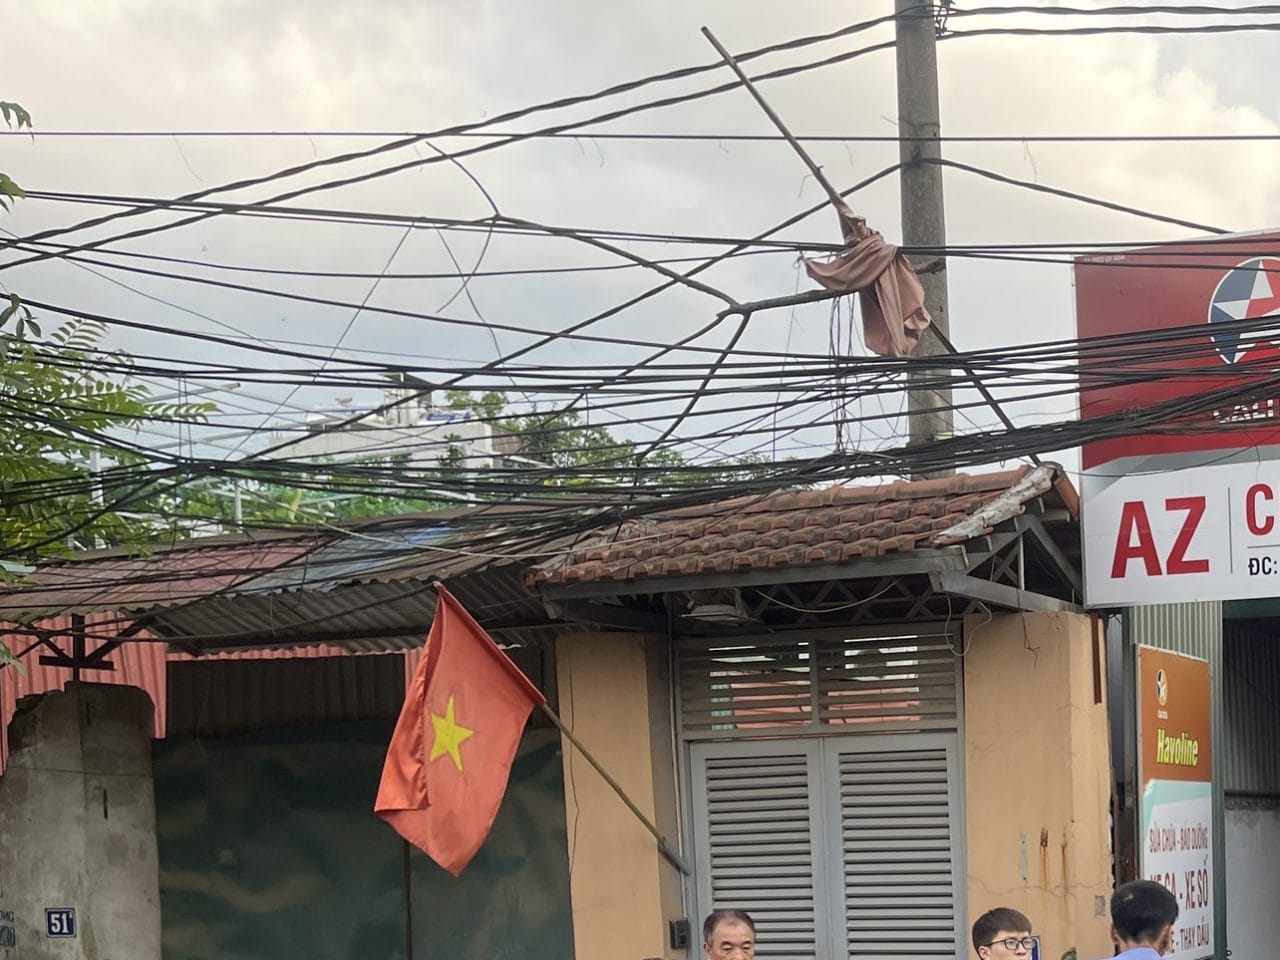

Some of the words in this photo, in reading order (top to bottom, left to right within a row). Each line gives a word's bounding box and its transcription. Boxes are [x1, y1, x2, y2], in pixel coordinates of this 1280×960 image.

[1110, 495, 1210, 580] AZ
[1247, 556, 1279, 576] ĐC:
[1156, 727, 1199, 768] Havoline
[1185, 870, 1196, 910] XE
